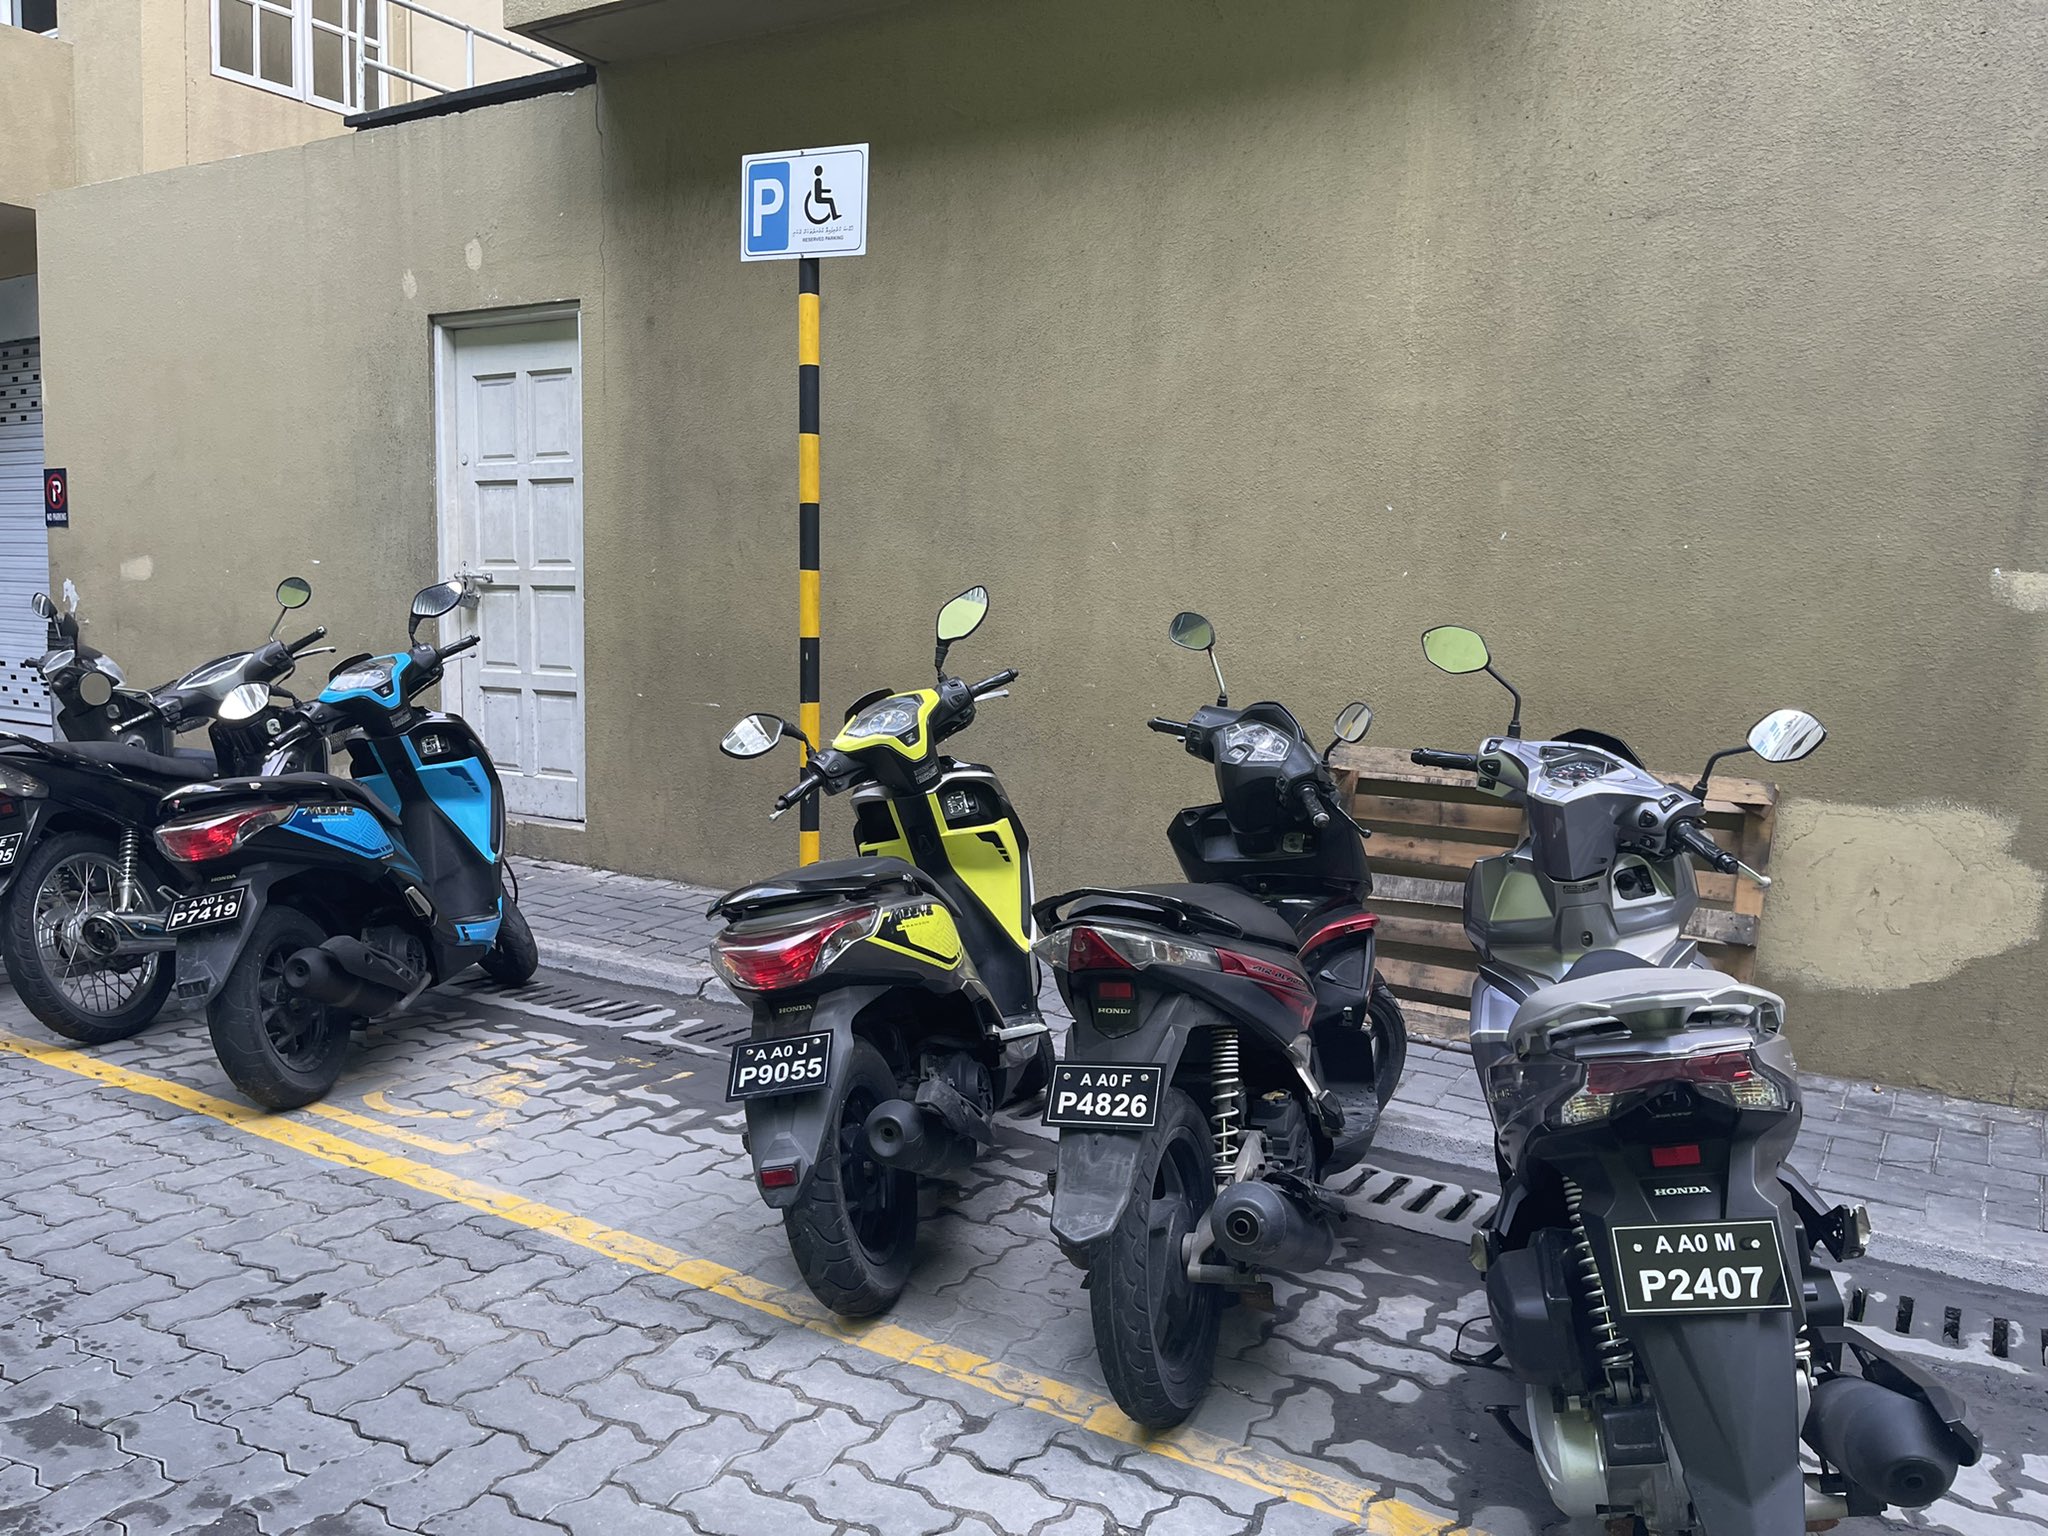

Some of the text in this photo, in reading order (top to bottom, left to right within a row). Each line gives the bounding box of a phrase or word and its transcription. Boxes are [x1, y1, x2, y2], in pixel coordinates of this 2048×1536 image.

[753, 178, 785, 237] P
[210, 874, 237, 882] HONDA
[217, 895, 225, 903] L
[171, 901, 237, 927] P7419
[779, 1004, 812, 1014] HONDA
[754, 1049, 767, 1062] A
[797, 1042, 808, 1056] J
[738, 1057, 822, 1089] P9055
[1080, 1073, 1092, 1086] A
[1122, 1074, 1132, 1088] F
[1057, 1091, 1148, 1118] P4826
[1654, 1186, 1712, 1196] HONDA
[1655, 1235, 1674, 1254] A
[1714, 1232, 1736, 1252] M
[1639, 1266, 1764, 1302] P2407
